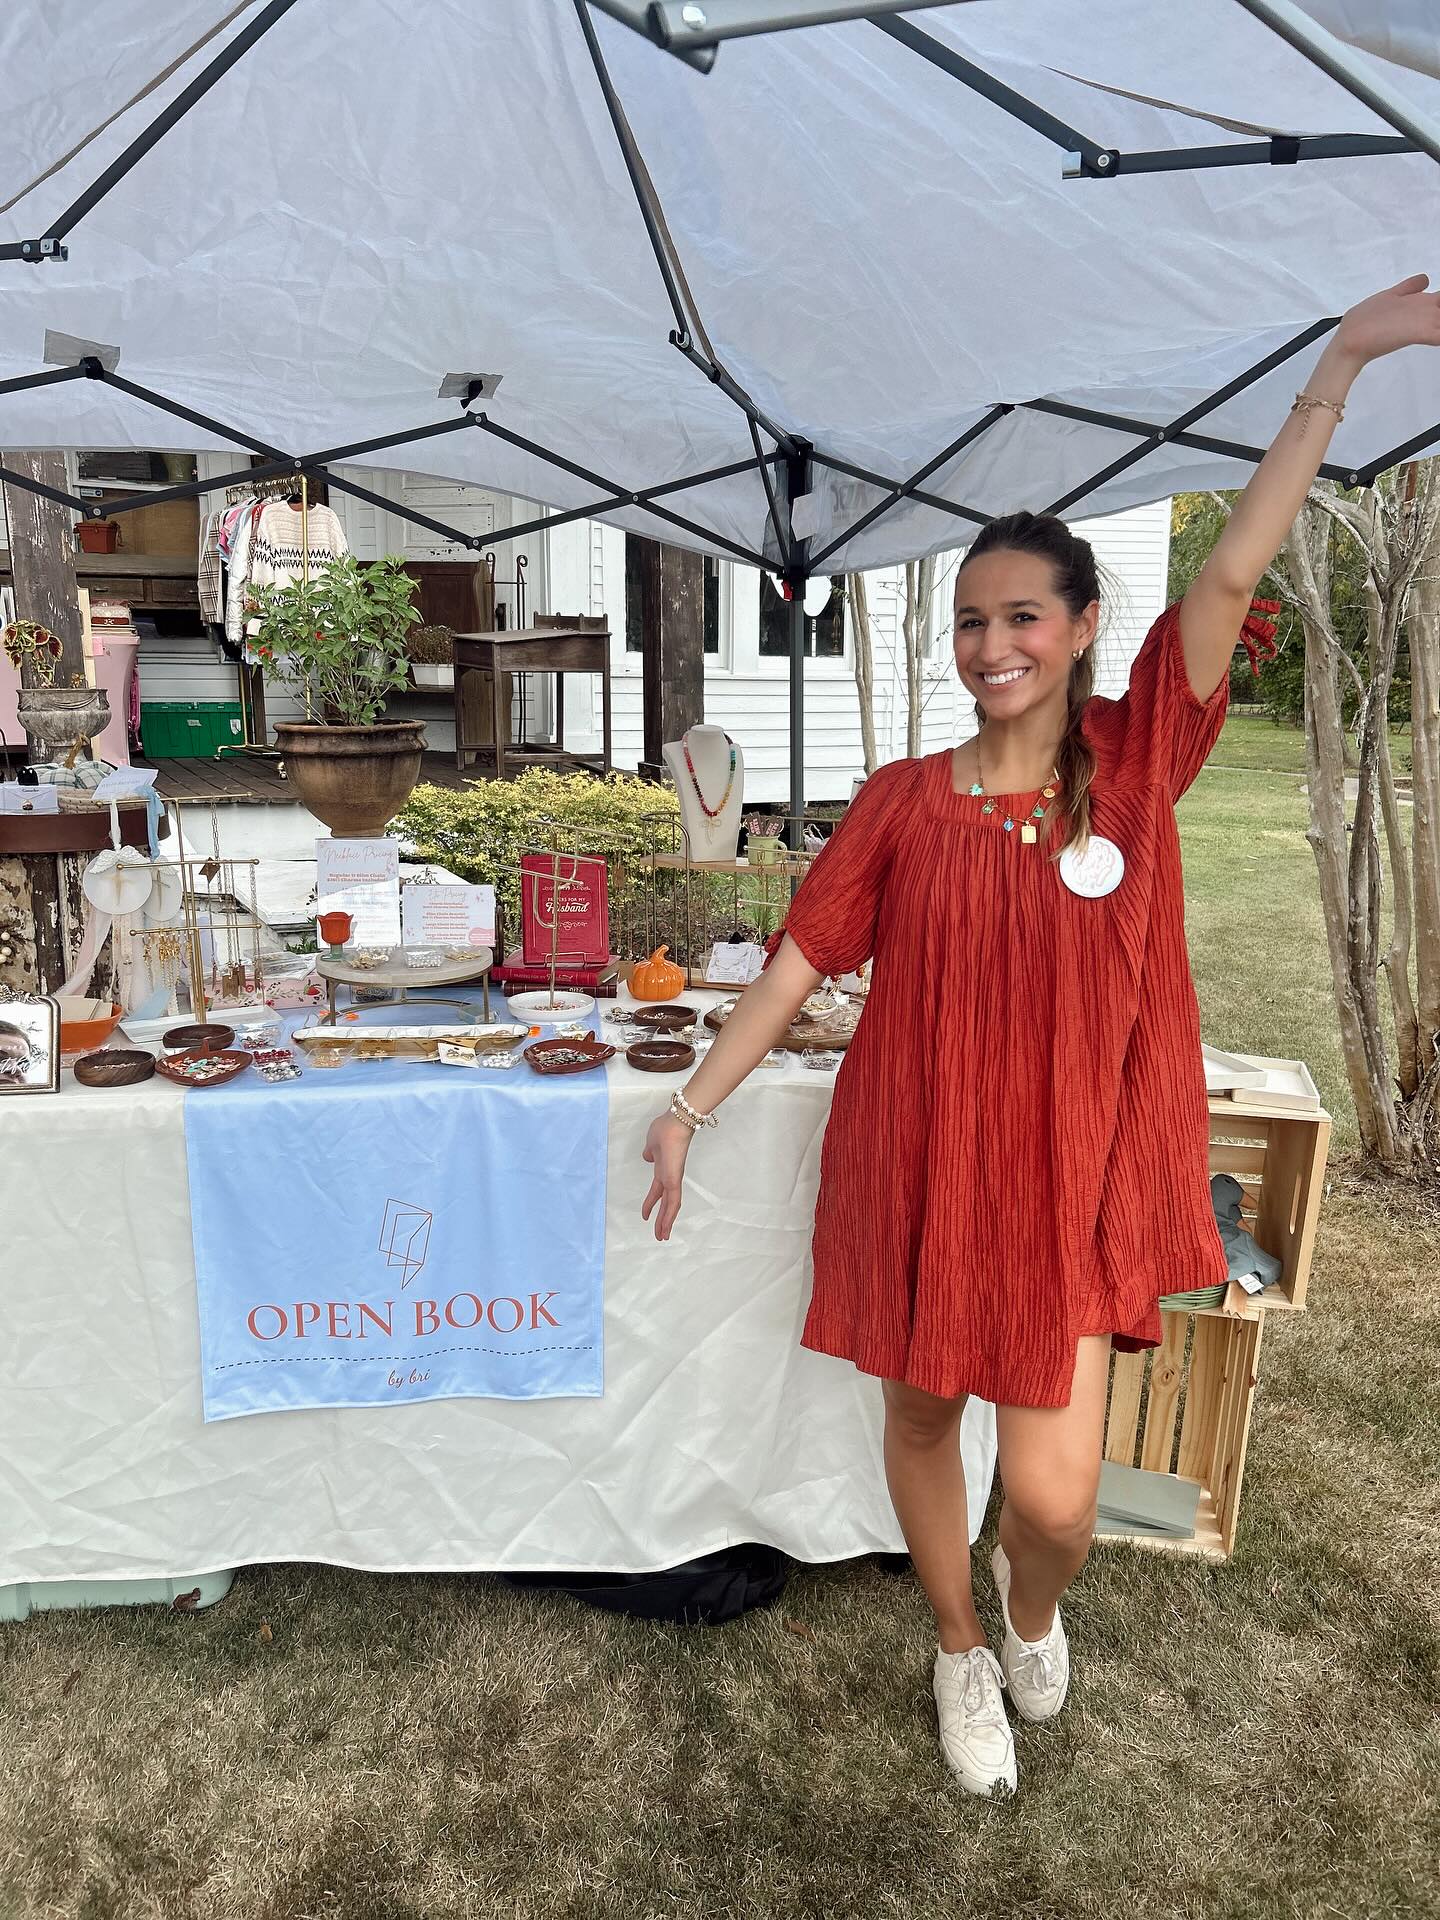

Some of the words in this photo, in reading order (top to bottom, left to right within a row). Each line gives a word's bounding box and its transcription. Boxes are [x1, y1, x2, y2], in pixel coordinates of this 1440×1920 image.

[247, 1301, 396, 1340] OPEN
[412, 1291, 562, 1337] BOOK
[388, 1369, 404, 1389] by
[409, 1368, 431, 1384] bri
